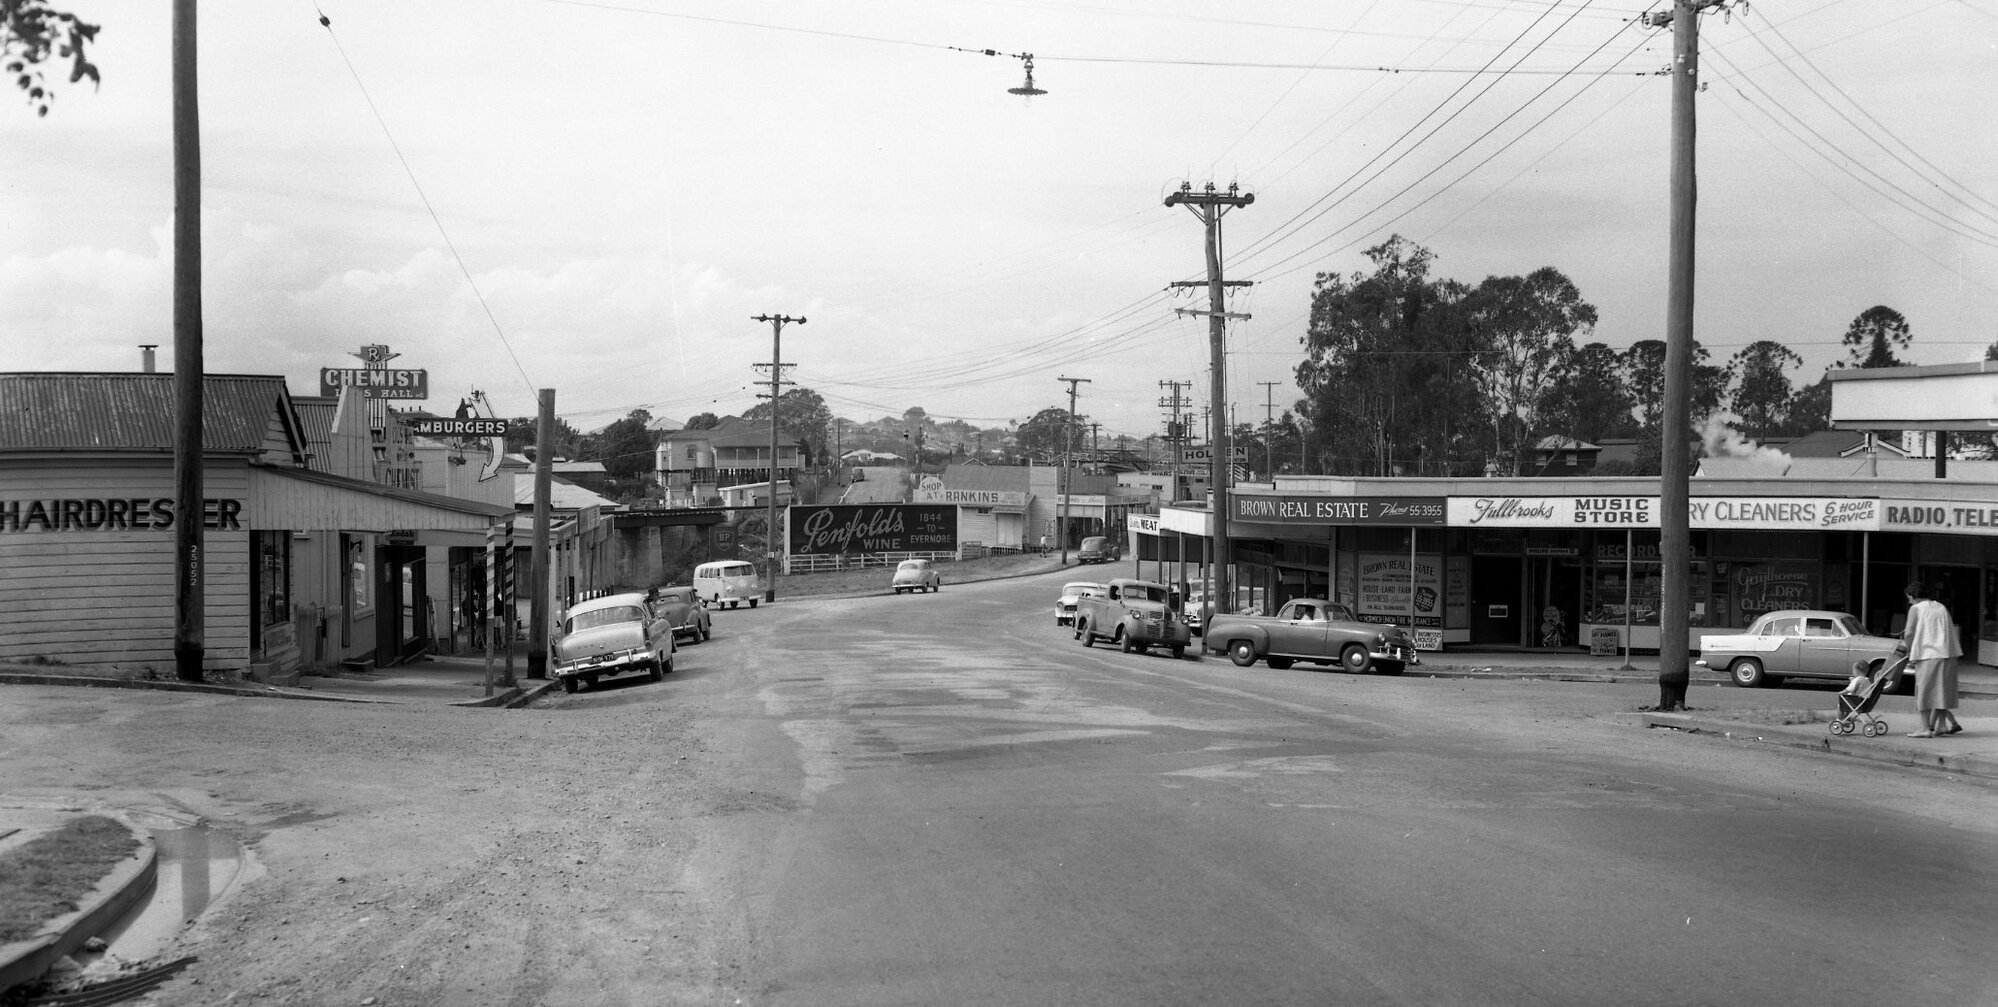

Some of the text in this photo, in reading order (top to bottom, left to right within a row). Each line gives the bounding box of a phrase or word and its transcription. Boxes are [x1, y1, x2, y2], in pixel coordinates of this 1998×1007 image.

[325, 370, 422, 387] CHEMIST
[381, 389, 413, 398] HALL
[414, 420, 506, 434] MBURGERS
[1185, 448, 1245, 459] HOLEN
[921, 482, 942, 491] SHOP
[945, 490, 999, 503] RANKINS
[1240, 500, 1276, 516] BROWN
[1279, 501, 1311, 518] REAL
[1316, 502, 1369, 518] ESTATE
[1379, 502, 1409, 517] Phone
[1470, 498, 1555, 523] Fullbrooks
[1575, 498, 1649, 510] MUSIC
[1825, 501, 1873, 515] 6 HOUR
[0, 498, 242, 531] HAIRDRESER
[1574, 511, 1649, 523] STORE
[1689, 501, 1816, 521] RY CLEANERS
[919, 513, 943, 523] 1844
[1821, 510, 1875, 527] SERVICE
[801, 507, 904, 552] Penfolds
[926, 524, 937, 533] TO
[719, 533, 730, 541] BP
[910, 534, 952, 543] EVERMORE
[863, 538, 901, 550] WINE
[190, 544, 198, 586] 25052
[1738, 566, 1809, 602] Gaythorne
